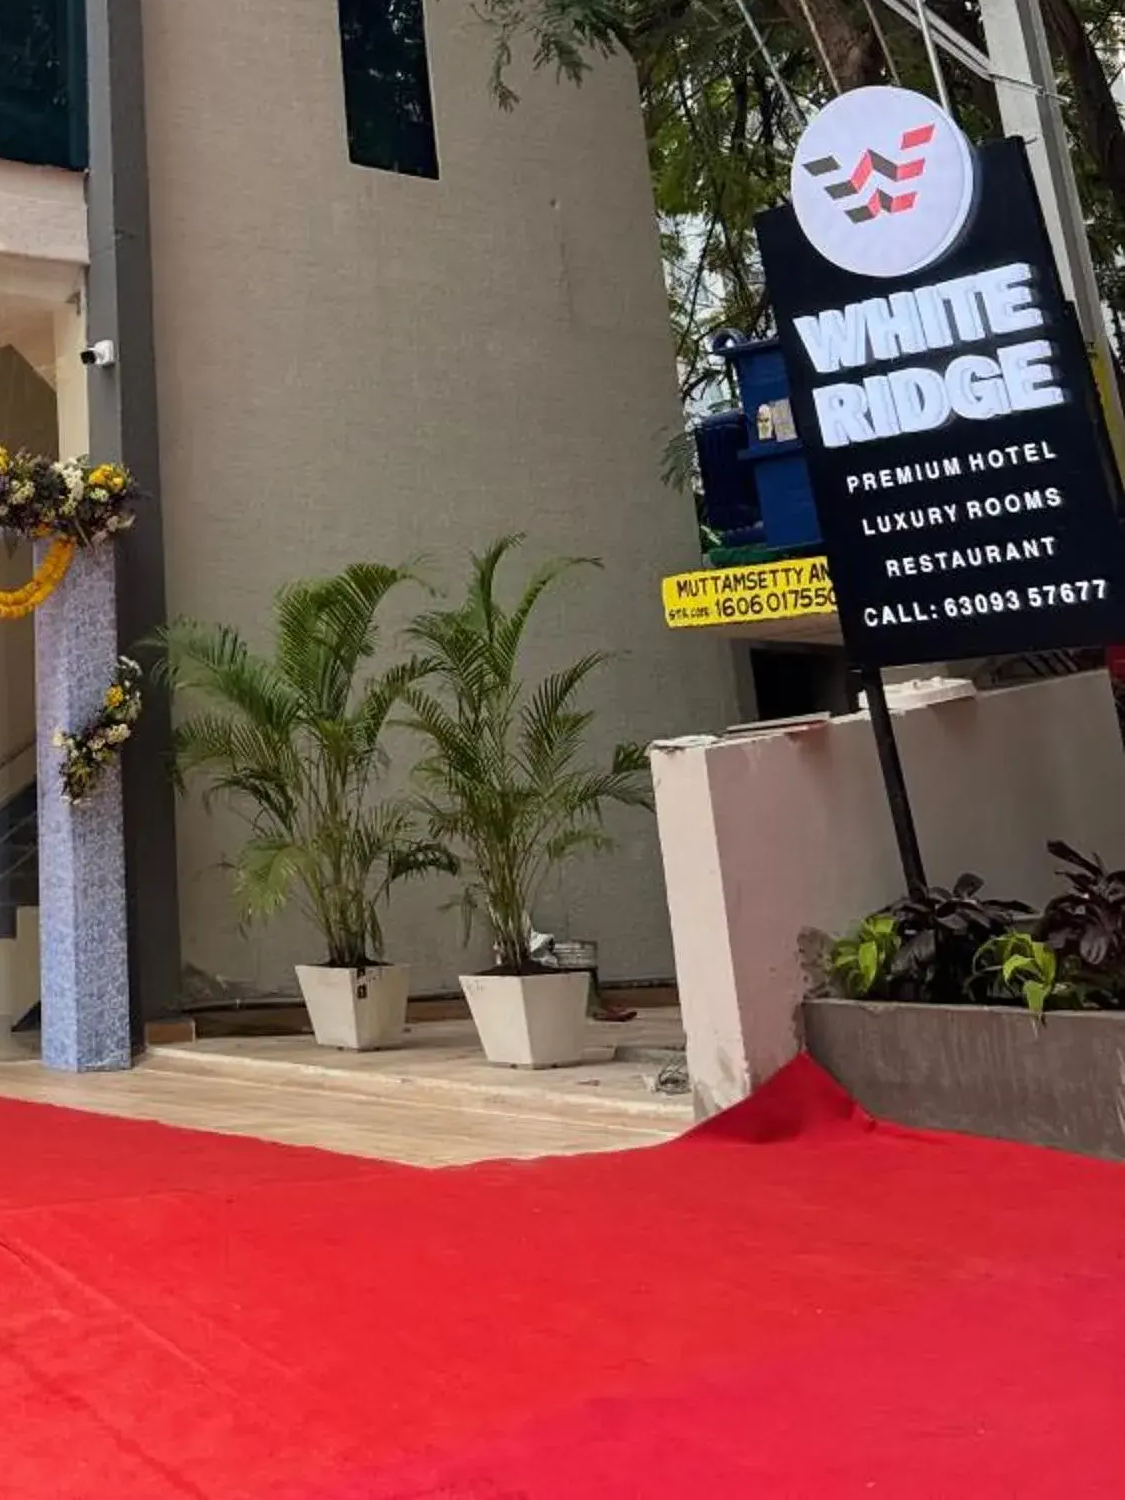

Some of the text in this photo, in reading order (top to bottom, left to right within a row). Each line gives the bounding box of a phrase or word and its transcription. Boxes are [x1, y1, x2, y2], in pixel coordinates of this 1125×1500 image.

[792, 262, 1044, 373] WHITE
[812, 339, 1065, 448] RIDGE
[846, 441, 1057, 493] PREMIUM HOTEL
[862, 487, 1062, 536] LUXURY ROOMS
[885, 536, 1057, 577] RESTAURANT
[676, 567, 804, 599] MUTTAMSETTY
[864, 579, 1107, 627] CALL: 63093 57677
